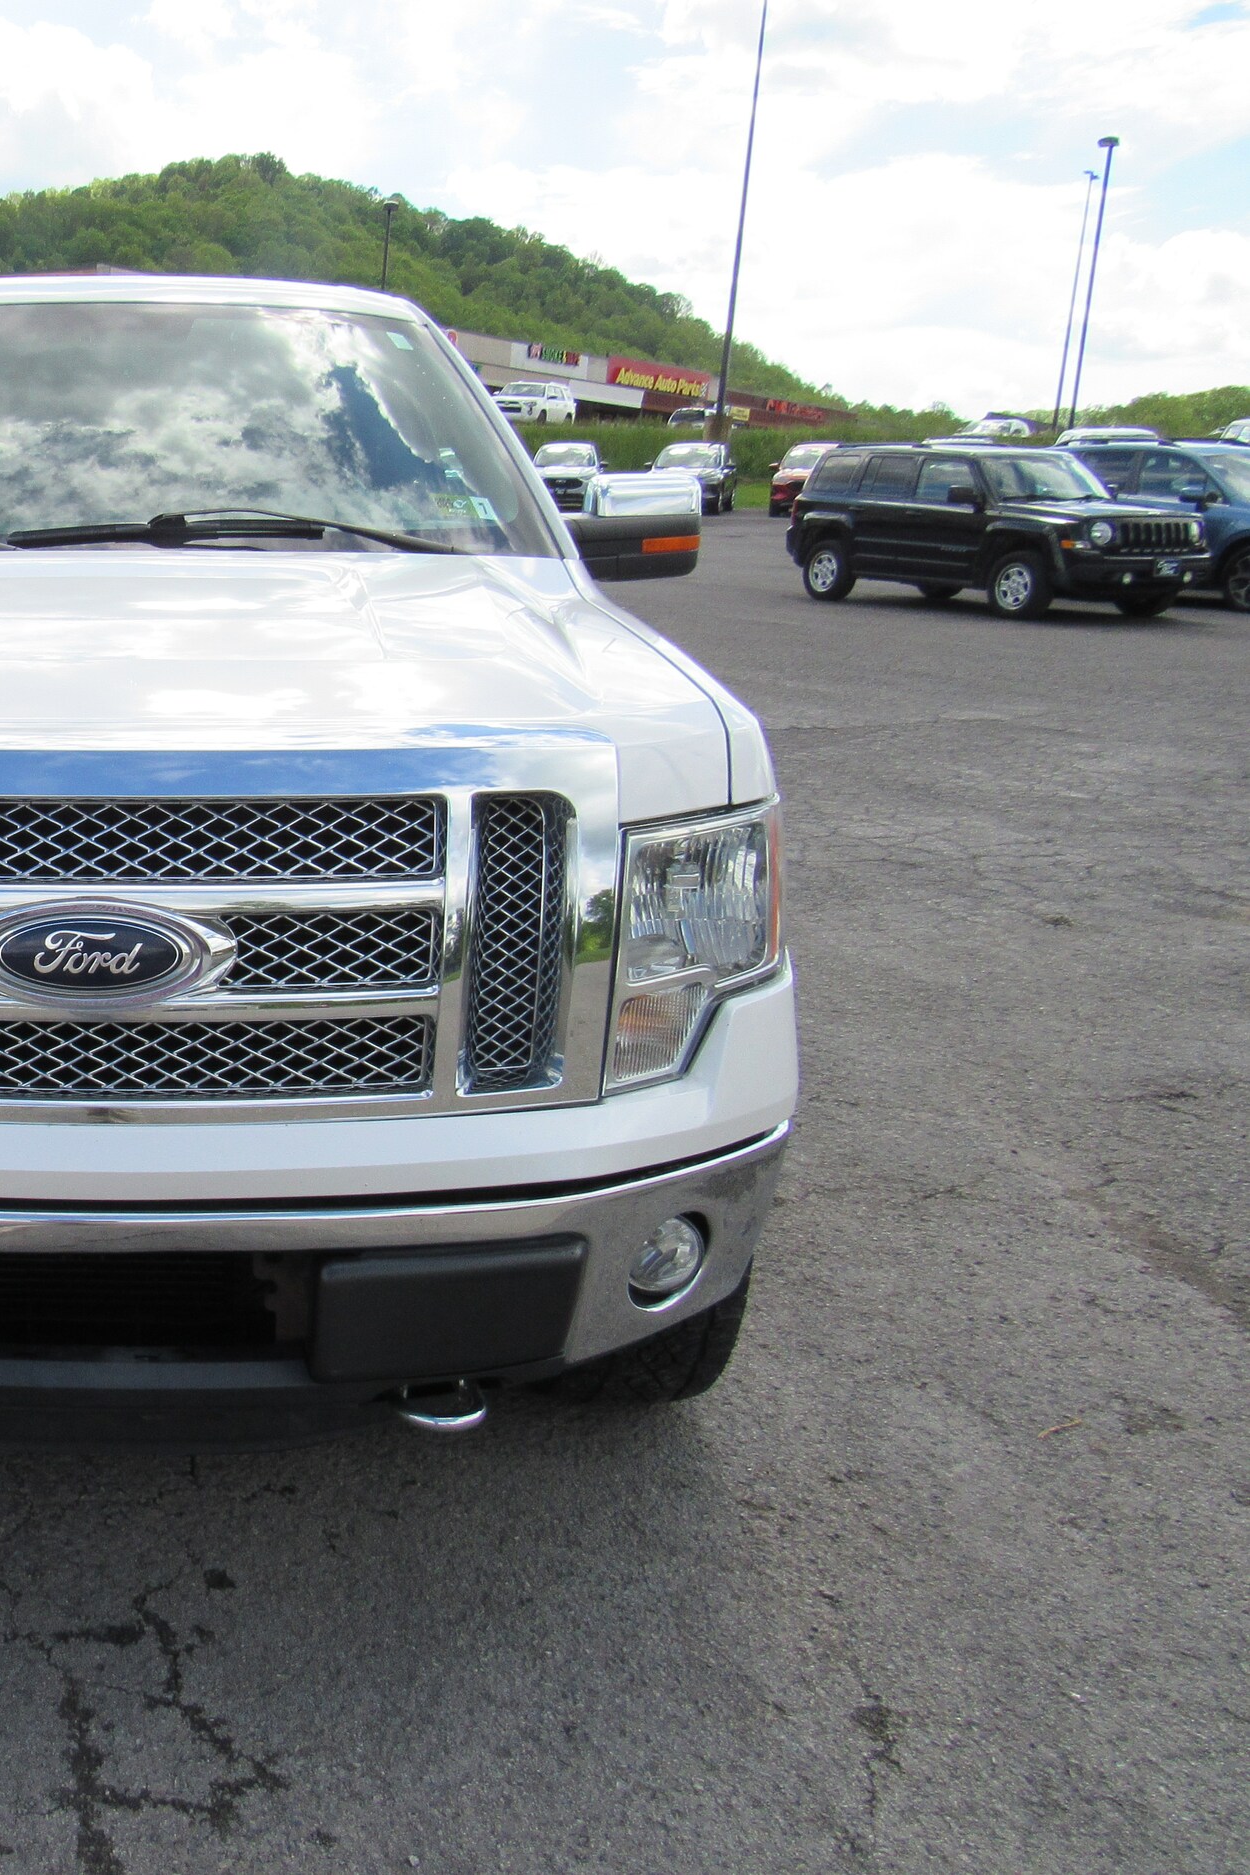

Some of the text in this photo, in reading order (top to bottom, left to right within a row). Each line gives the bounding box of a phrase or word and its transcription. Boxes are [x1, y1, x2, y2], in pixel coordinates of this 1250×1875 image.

[616, 367, 701, 397] Advance Auto Parts
[34, 930, 144, 974] Ford
